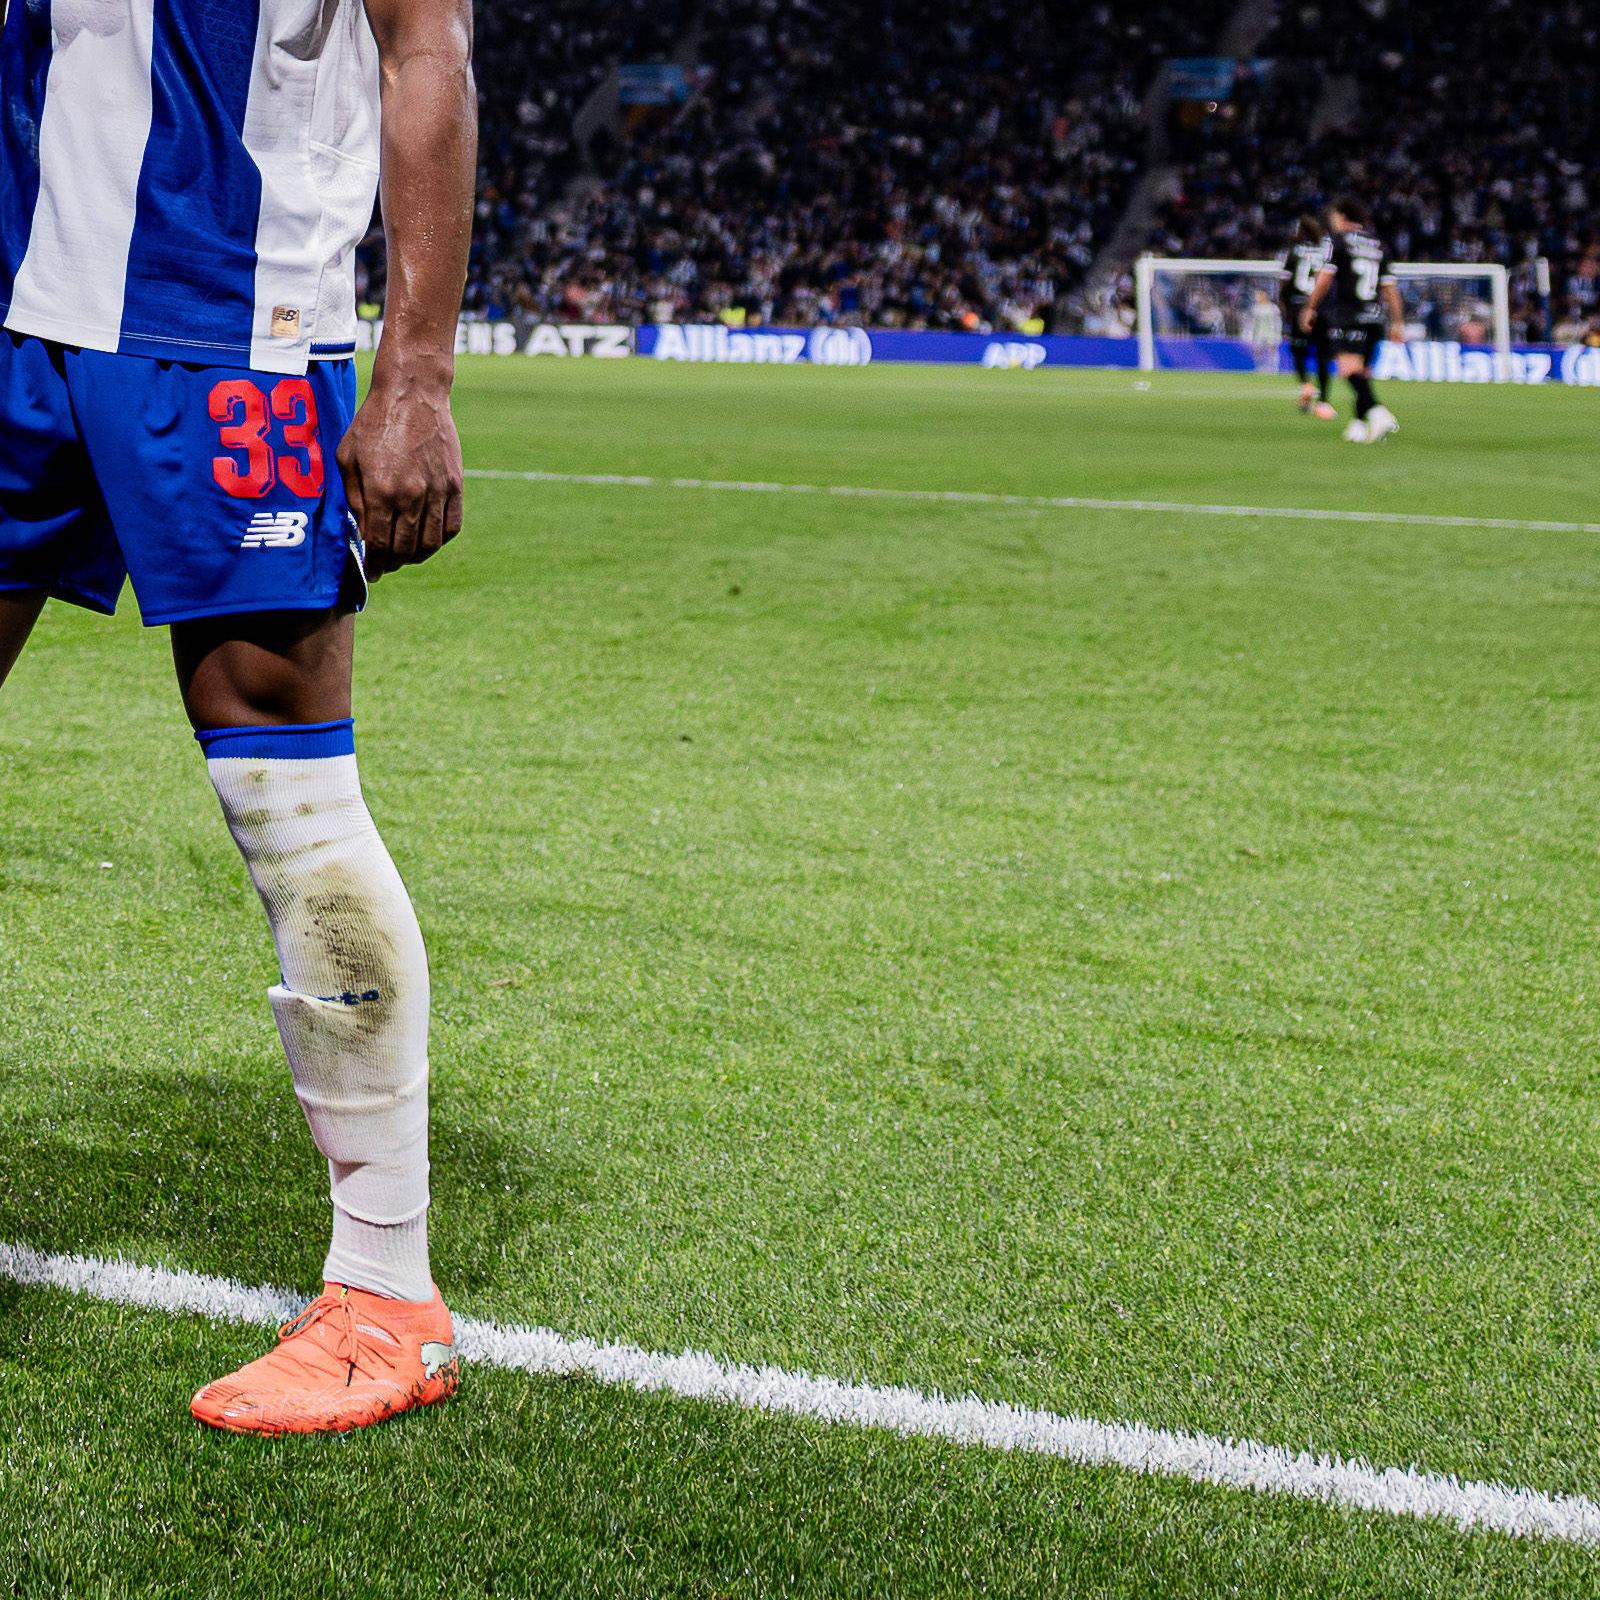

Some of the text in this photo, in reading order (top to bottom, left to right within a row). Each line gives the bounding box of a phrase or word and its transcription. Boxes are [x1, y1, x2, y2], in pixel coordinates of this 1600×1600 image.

[655, 323, 806, 365] Allianz
[1372, 339, 1552, 384] Allianz
[208, 379, 326, 498] 33
